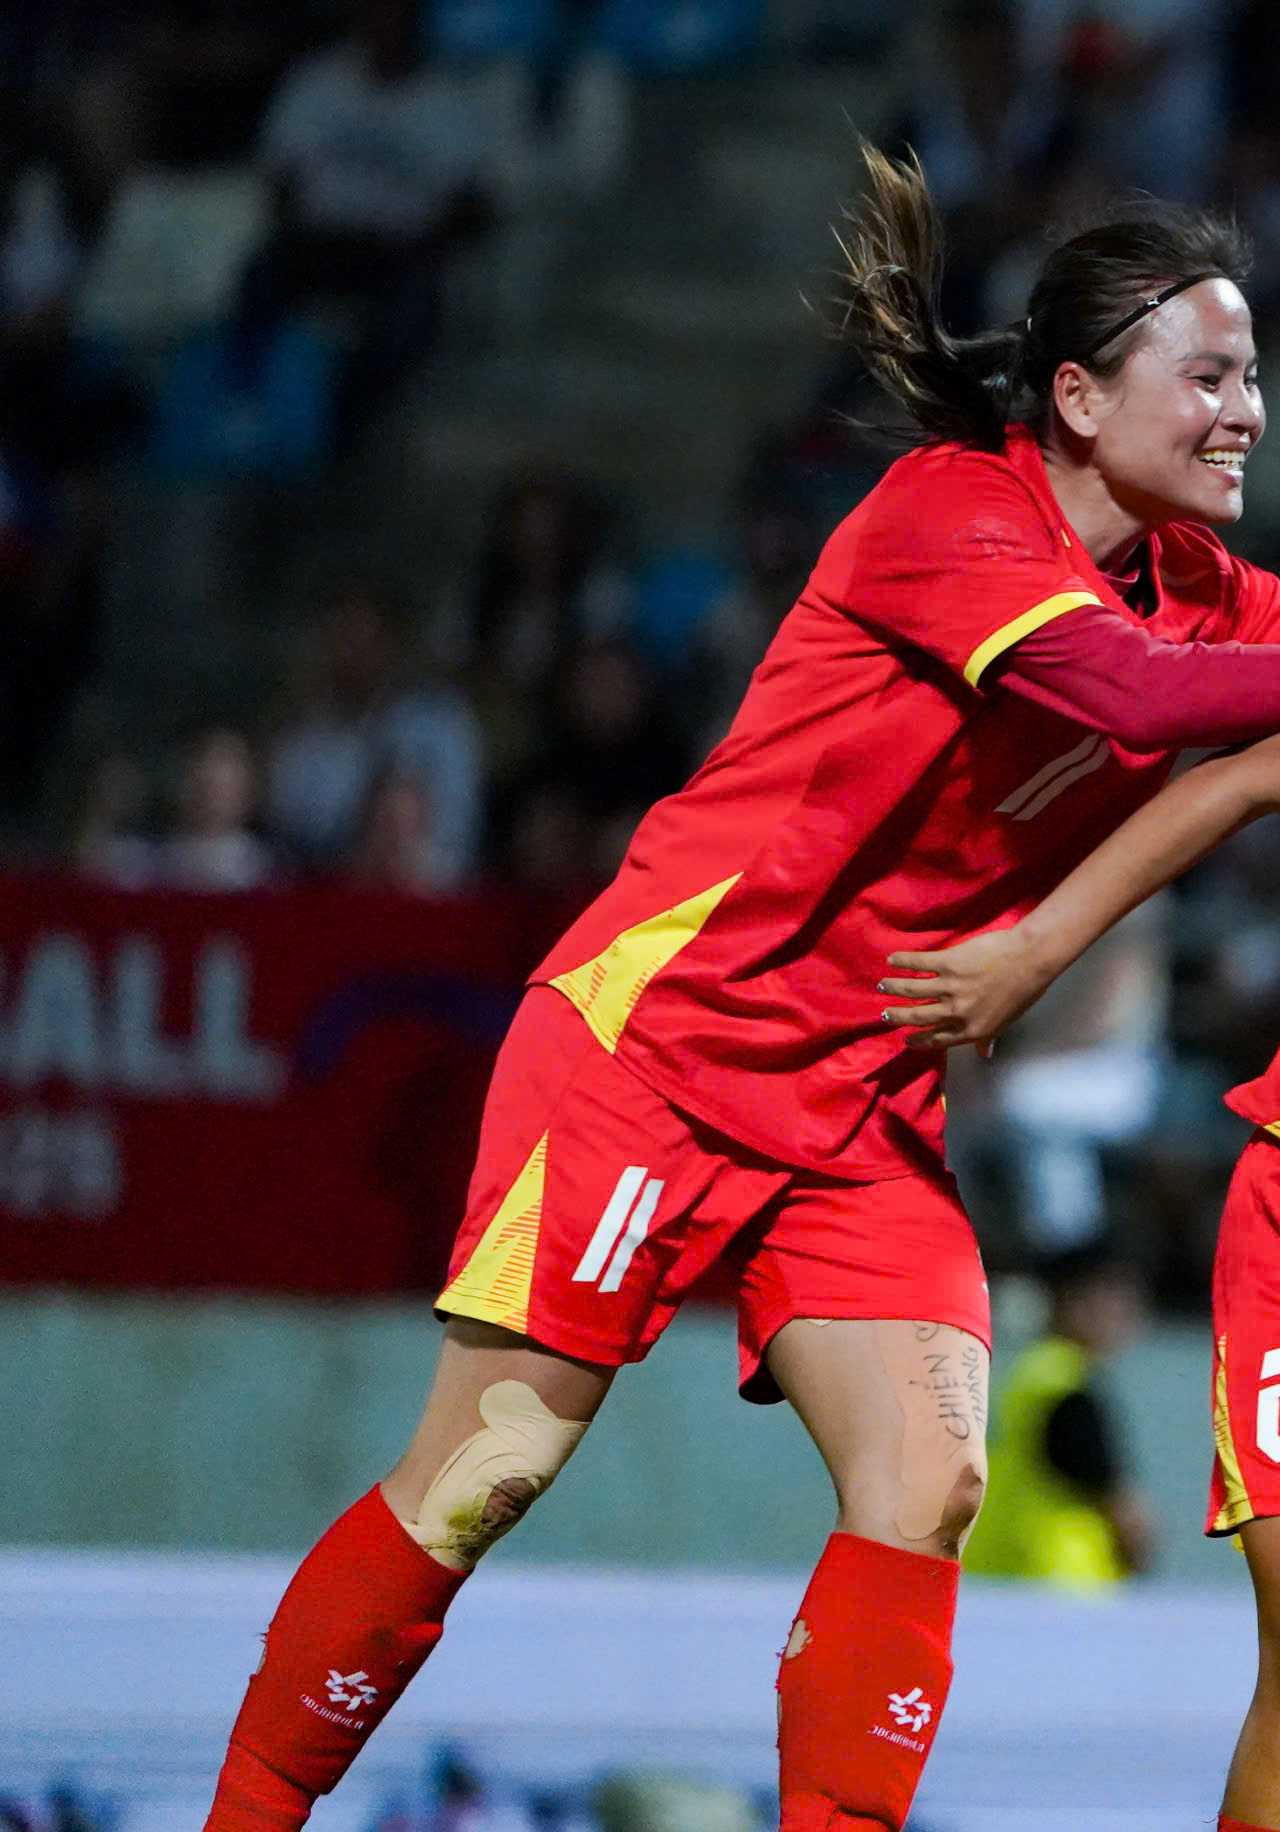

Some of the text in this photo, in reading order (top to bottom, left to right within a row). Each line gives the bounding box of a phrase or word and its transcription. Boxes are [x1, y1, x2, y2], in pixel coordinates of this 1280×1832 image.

[992, 732, 1111, 822] 11
[0, 934, 286, 1098] ALL
[571, 1165, 665, 1293] 11
